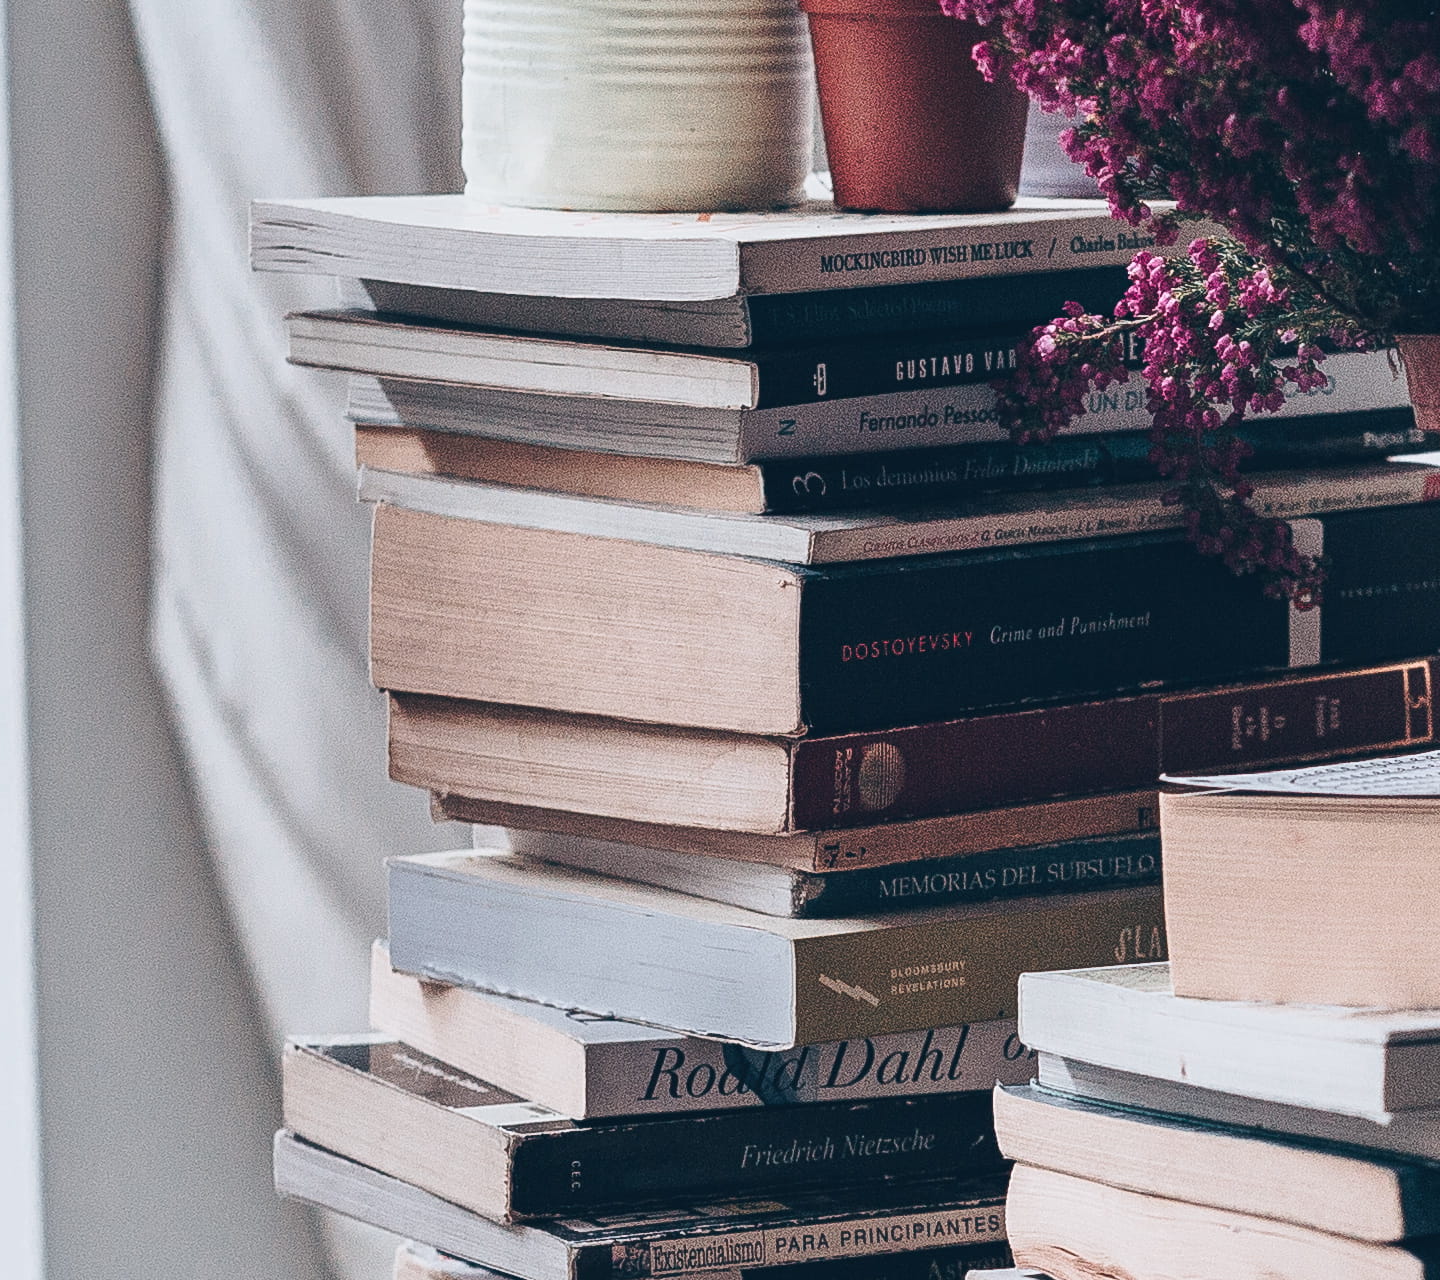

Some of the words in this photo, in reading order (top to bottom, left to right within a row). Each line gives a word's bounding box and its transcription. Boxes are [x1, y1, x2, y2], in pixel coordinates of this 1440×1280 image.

[820, 248, 927, 274] MOCKINGBIRD
[930, 242, 969, 265] WISH
[971, 241, 993, 262] ME
[995, 239, 1035, 261] LUCK
[1070, 235, 1115, 254] Charles
[895, 351, 976, 382] GUSTAVO
[984, 348, 1017, 373] VAR
[860, 403, 939, 434] Fernando
[1089, 390, 1117, 414] UN
[841, 467, 871, 490] Los
[876, 462, 958, 487] demonios
[842, 630, 974, 662] DOSTOYEVSKY
[989, 621, 1032, 646] Crime
[1037, 617, 1065, 640] and
[1070, 610, 1152, 636] Punishment
[879, 869, 997, 901] MEMORIAS
[1002, 863, 1044, 888] DEL
[1048, 853, 1155, 884] SUBSUELO
[890, 960, 966, 980] BLOOMSBURY
[890, 976, 967, 996] REVELATIONS
[638, 1044, 809, 1102] Roald
[824, 1024, 970, 1088] Dahl
[740, 1134, 837, 1169] Friedrich
[842, 1127, 937, 1159] Nietzsche
[653, 1238, 764, 1272] Existencialismo
[775, 1232, 829, 1256] PARA
[839, 1213, 1001, 1248] PRINCIPIANTES
